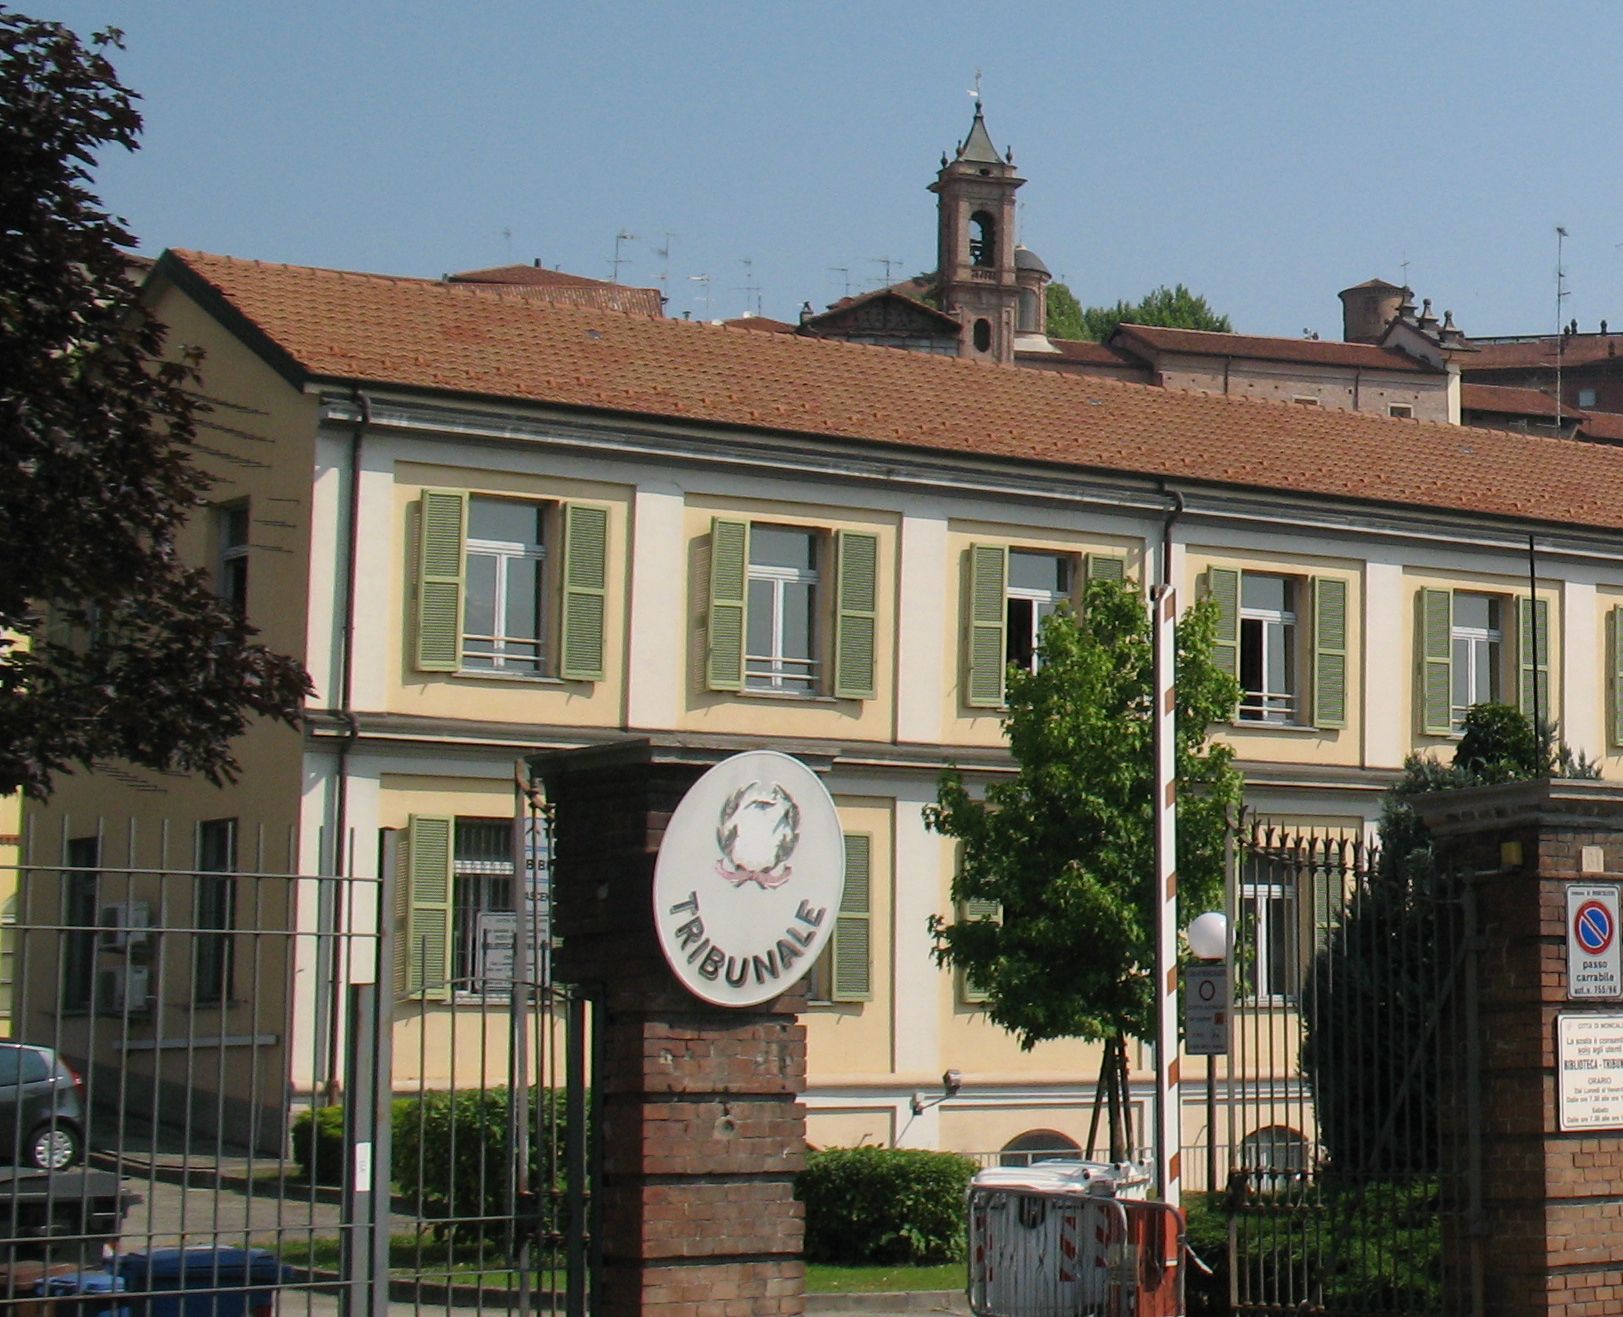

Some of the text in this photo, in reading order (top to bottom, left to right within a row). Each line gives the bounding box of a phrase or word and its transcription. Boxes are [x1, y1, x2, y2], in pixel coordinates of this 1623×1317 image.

[669, 890, 827, 988] TRIBUNALE
[1583, 961, 1608, 970] passo
[1576, 972, 1614, 981] carrabile
[1564, 1060, 1598, 1070] BIBLIOTECA
[1588, 1077, 1612, 1085] ORARIO
